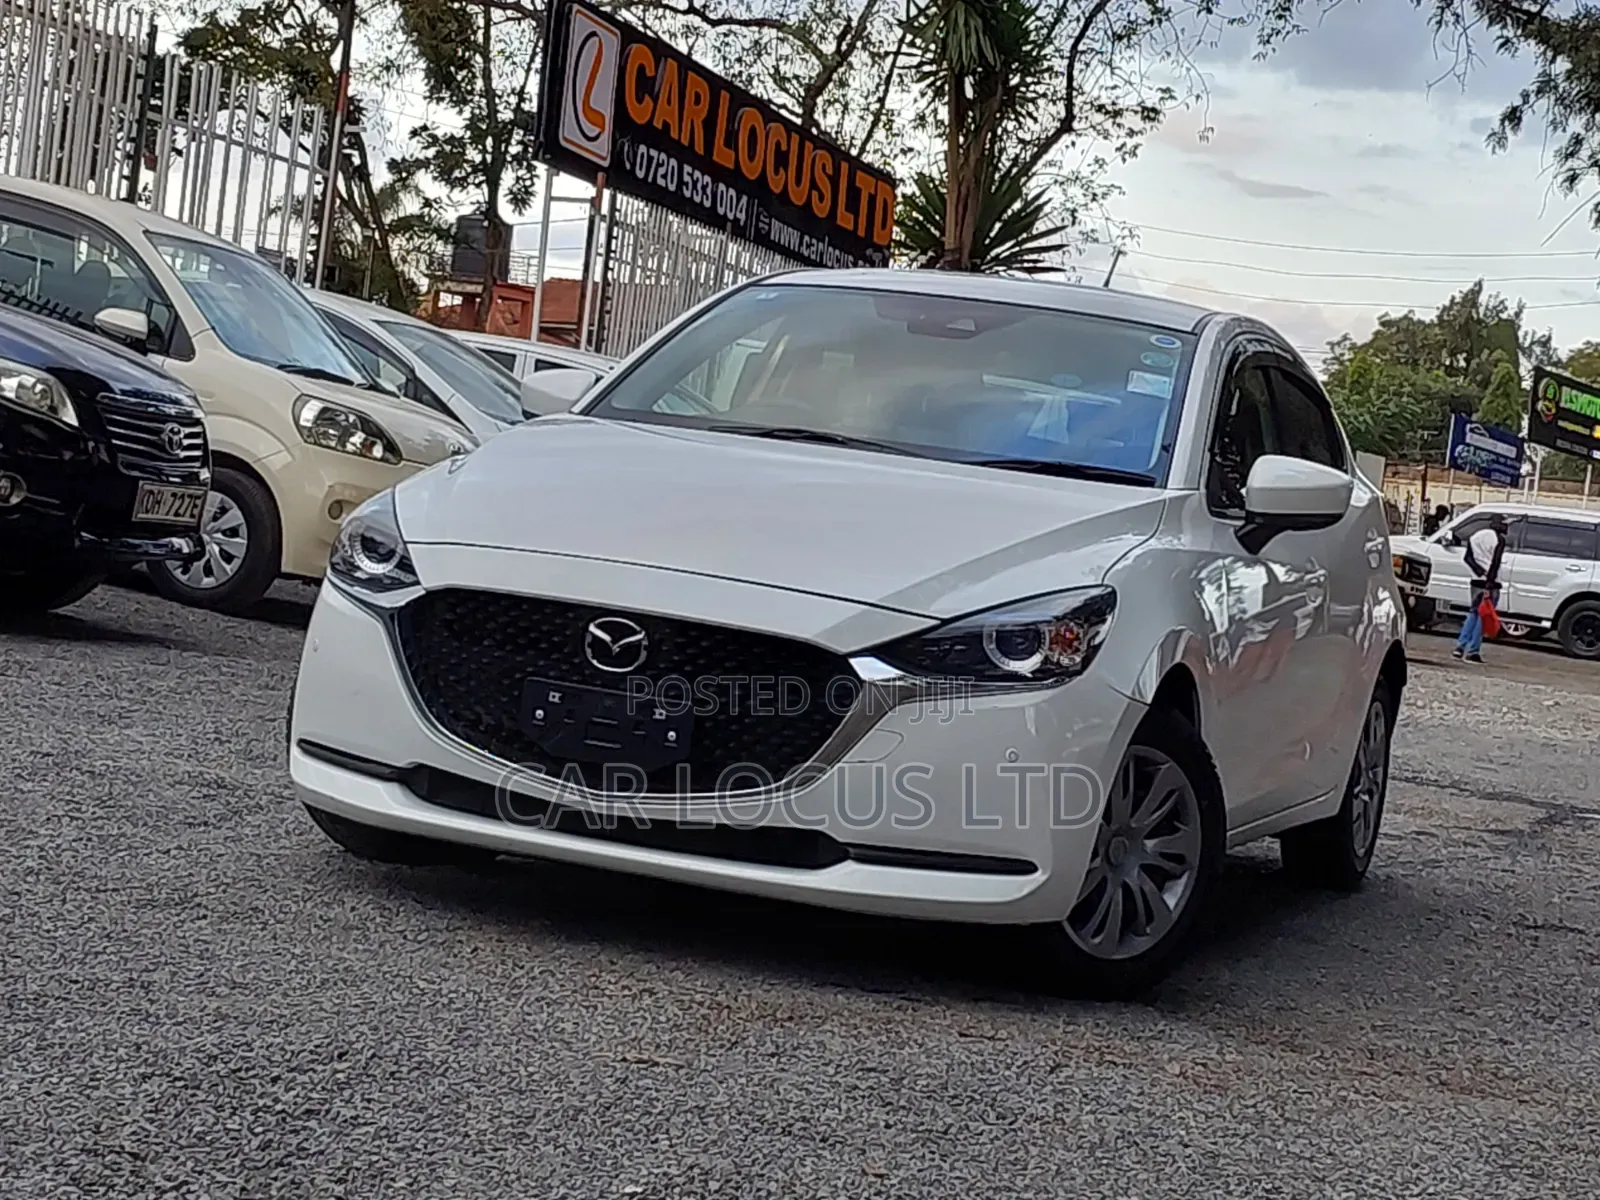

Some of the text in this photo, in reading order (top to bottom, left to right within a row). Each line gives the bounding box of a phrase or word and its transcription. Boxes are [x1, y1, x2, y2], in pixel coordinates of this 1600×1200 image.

[624, 43, 895, 246] CAR LOCUS LTD
[635, 143, 678, 192] 0720
[683, 163, 712, 208] 533
[717, 182, 748, 226] 004
[165, 491, 203, 519] 727E
